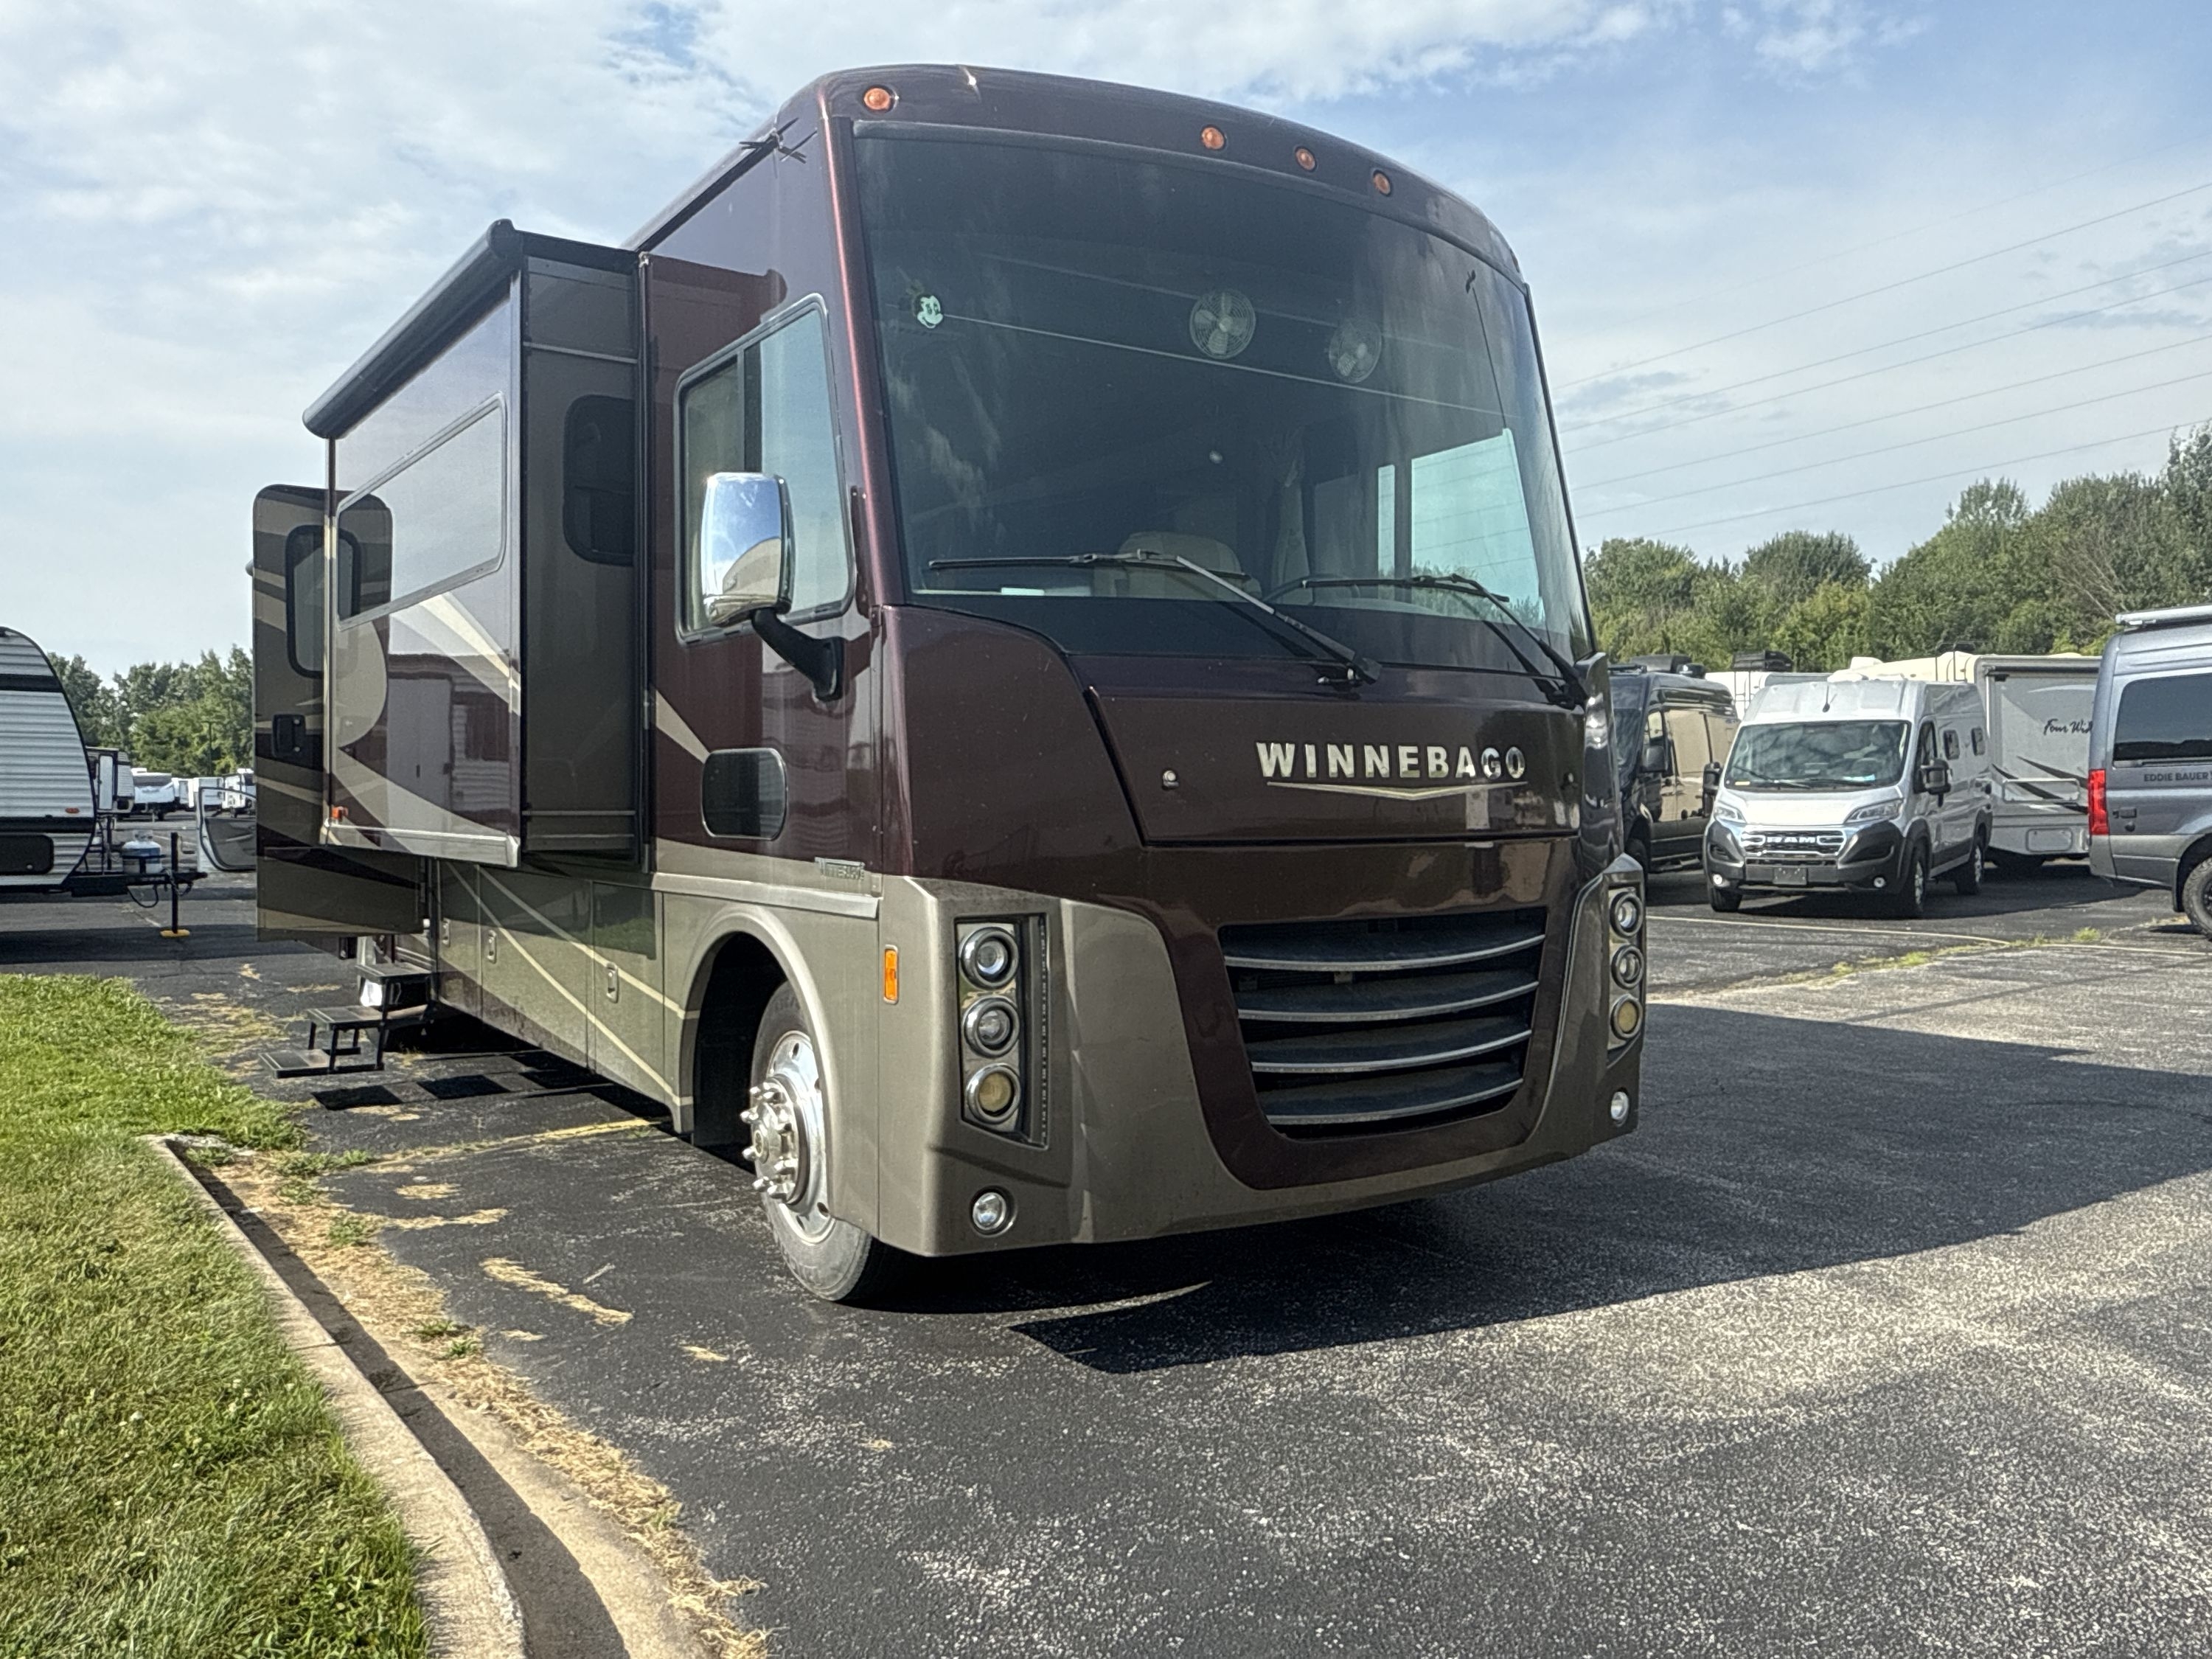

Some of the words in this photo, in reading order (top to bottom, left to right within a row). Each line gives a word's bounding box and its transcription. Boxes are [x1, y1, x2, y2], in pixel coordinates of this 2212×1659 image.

[2043, 718, 2068, 736] Four
[1256, 742, 1526, 779] WINNEBAGO
[2143, 773, 2174, 782] EDDIE
[2175, 771, 2209, 781] BAUER
